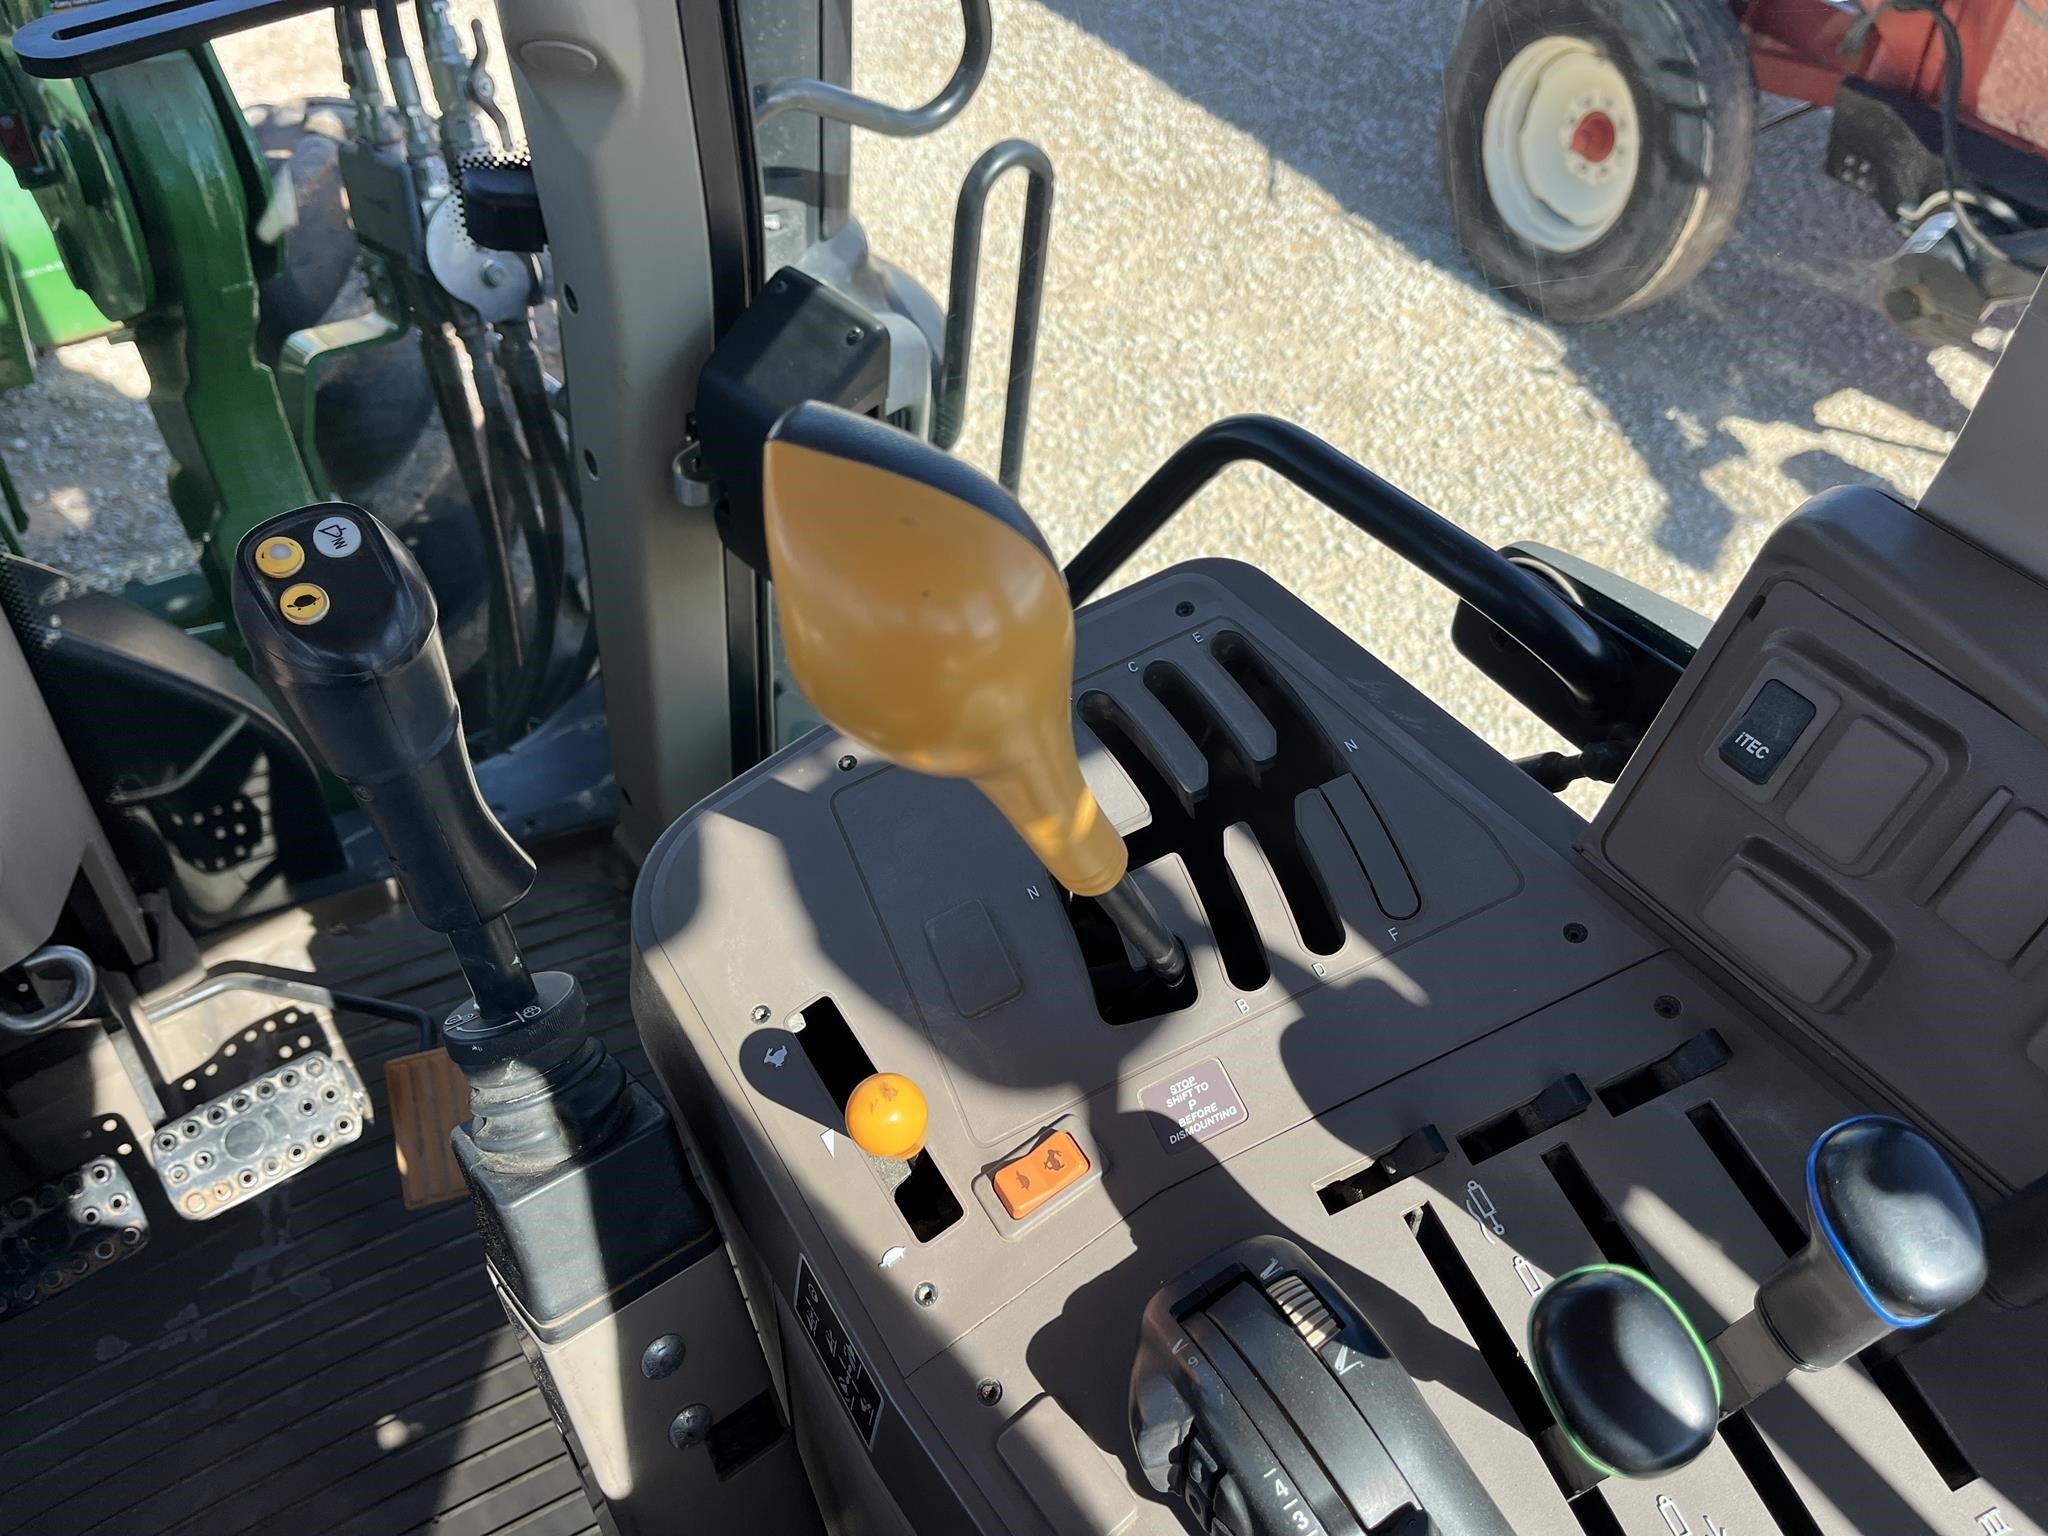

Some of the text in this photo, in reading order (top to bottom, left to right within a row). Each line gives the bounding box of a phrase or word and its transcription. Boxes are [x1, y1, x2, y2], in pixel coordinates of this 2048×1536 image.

[1192, 631, 1204, 643] E
[1127, 661, 1139, 673] C
[1343, 738, 1358, 753] N
[1026, 885, 1040, 900] N
[1387, 926, 1400, 942] F
[1311, 962, 1327, 978] D
[1234, 998, 1250, 1015] B
[1169, 1076, 1197, 1096] STOP
[1166, 1081, 1209, 1108] SHIFT TO
[1188, 1099, 1197, 1111] P
[1178, 1102, 1218, 1128] BEFORE
[1169, 1105, 1238, 1145] DISMOUNTING
[1275, 1478, 1289, 1497] 4
[1292, 1510, 1309, 1530] 3
